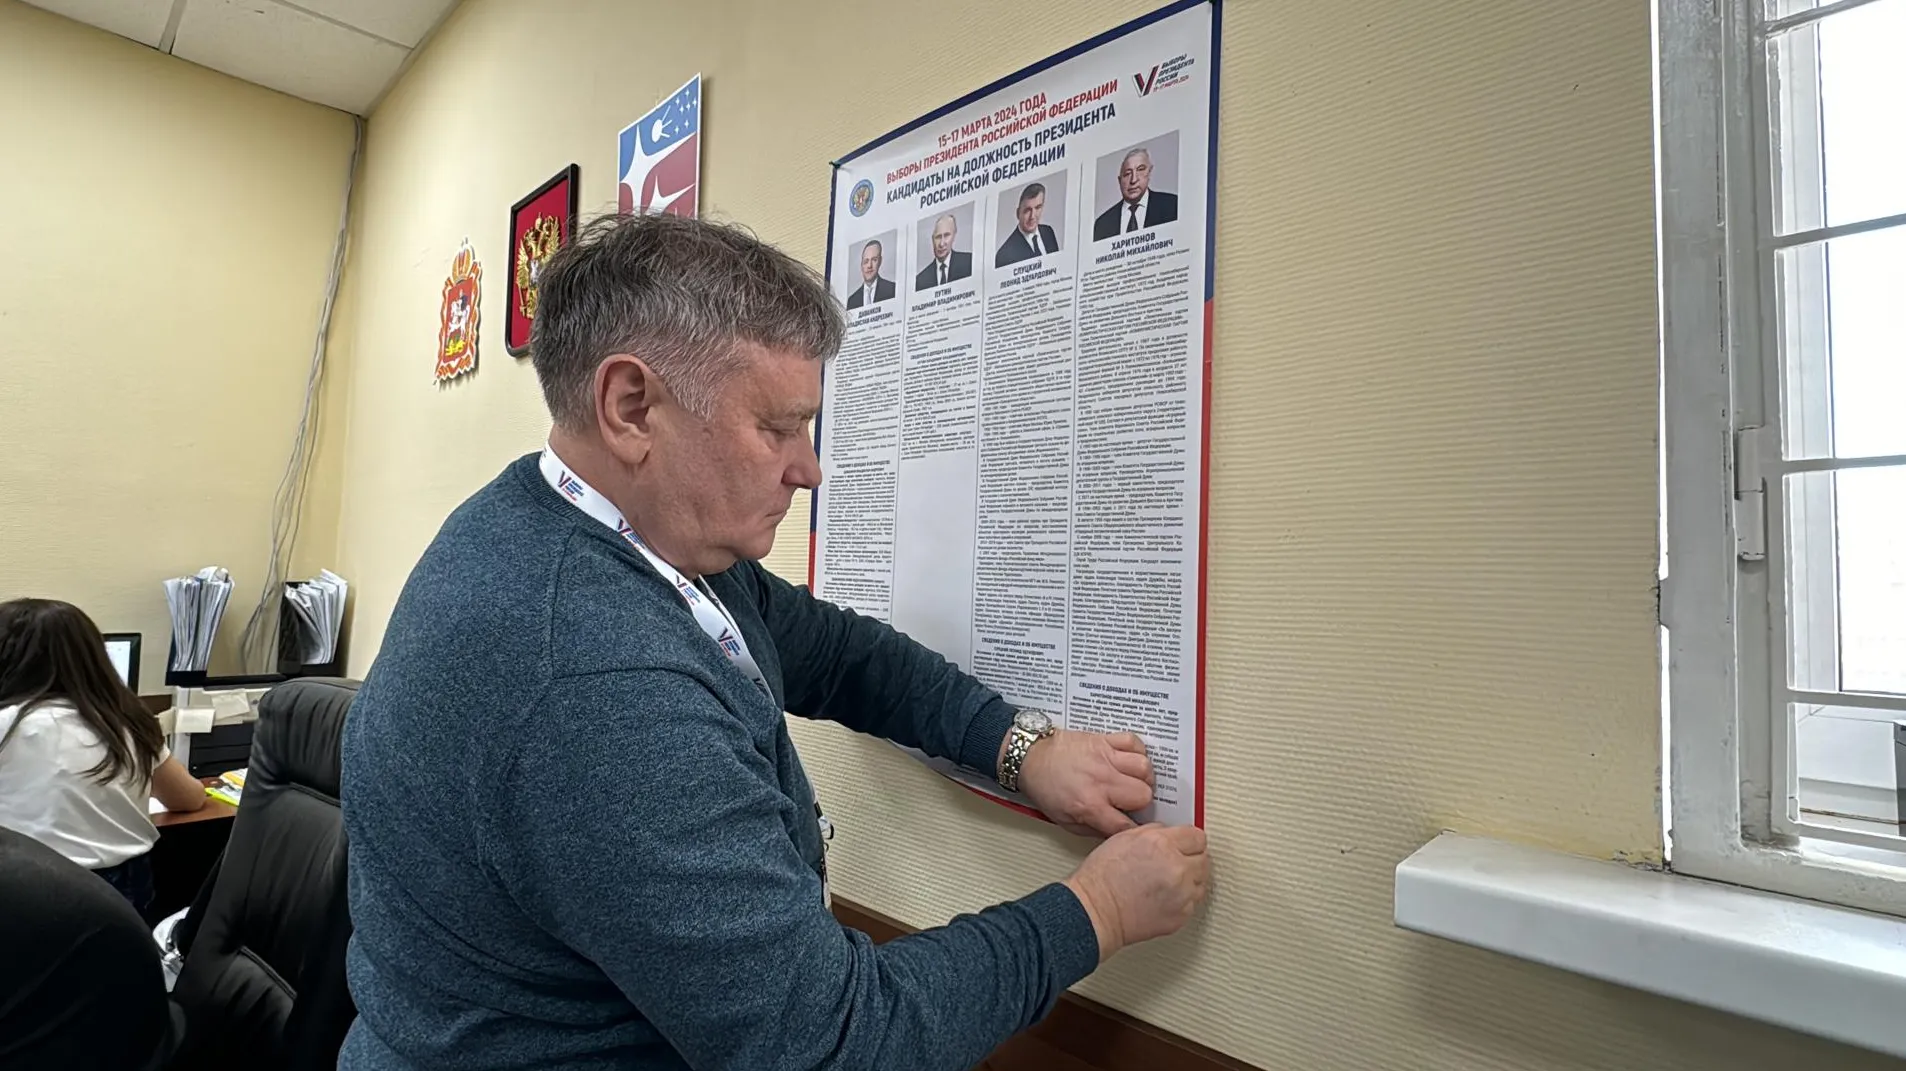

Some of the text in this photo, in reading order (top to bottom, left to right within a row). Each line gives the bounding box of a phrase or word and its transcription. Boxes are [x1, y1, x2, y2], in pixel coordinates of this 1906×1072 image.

[1158, 58, 1194, 77] ПРЕЗИДЕНТА
[1162, 53, 1187, 69] ВЫБОРЫ
[1156, 71, 1179, 85] РОССИИ
[938, 92, 1047, 148] 15-17 МАРТА 2024 ГОДА
[886, 79, 1118, 184] ВЫБОРЫ ПРЕЗИДЕНТА РОССИЙСКОЙ ФЕДЕРАЦИИ
[886, 169, 945, 204] КАНДИДАТЫ
[947, 164, 960, 182] НА
[962, 136, 1032, 178] ДОЛЖНОСТЬ
[1034, 102, 1116, 149] ПРЕЗИДЕНТА
[920, 170, 990, 209] РОССИЙСКОЙ
[992, 143, 1066, 184] ФЕДЕРАЦИИ
[1096, 239, 1174, 264] НИКОЛАЙ МИХАЙЛОВИЧ
[1112, 232, 1156, 251] ХАРИТОНОВ
[1000, 268, 1056, 289] ЛЕОНИД ЭДУАРДОВИЧ
[1013, 260, 1042, 276] СЛУЦКИЙ
[912, 290, 975, 312] ВЛАДИМИР ВЛАДИМИРОВИЧ
[934, 288, 952, 298] ПУТИН
